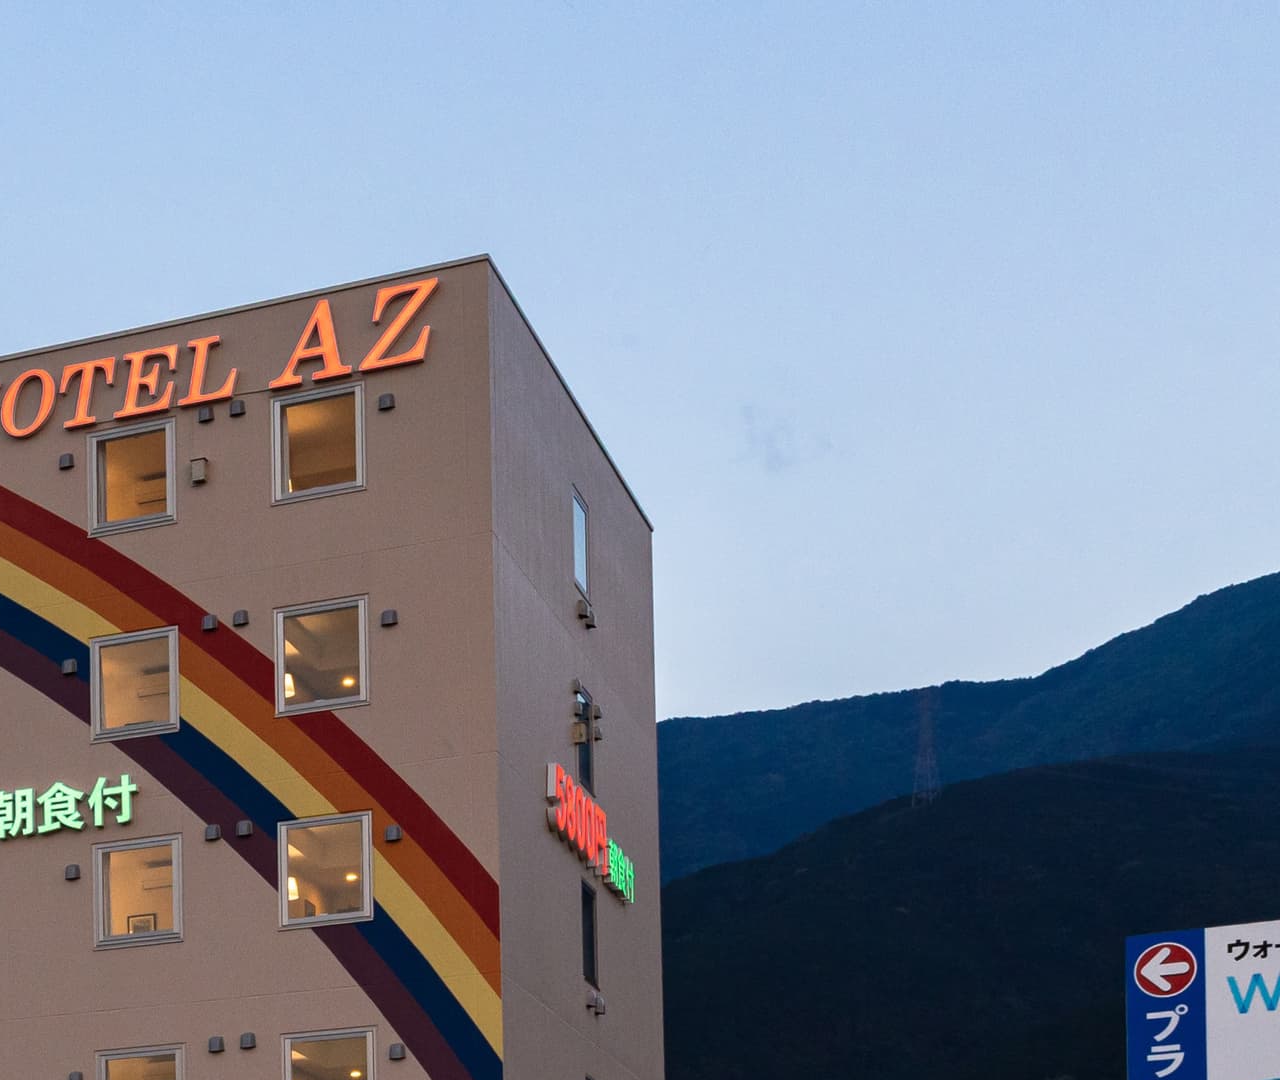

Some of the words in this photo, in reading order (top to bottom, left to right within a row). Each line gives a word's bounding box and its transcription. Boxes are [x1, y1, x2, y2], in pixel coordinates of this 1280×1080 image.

[268, 277, 439, 390] AZ
[552, 763, 609, 876] 5800円
[1226, 939, 1280, 961] ウォ
